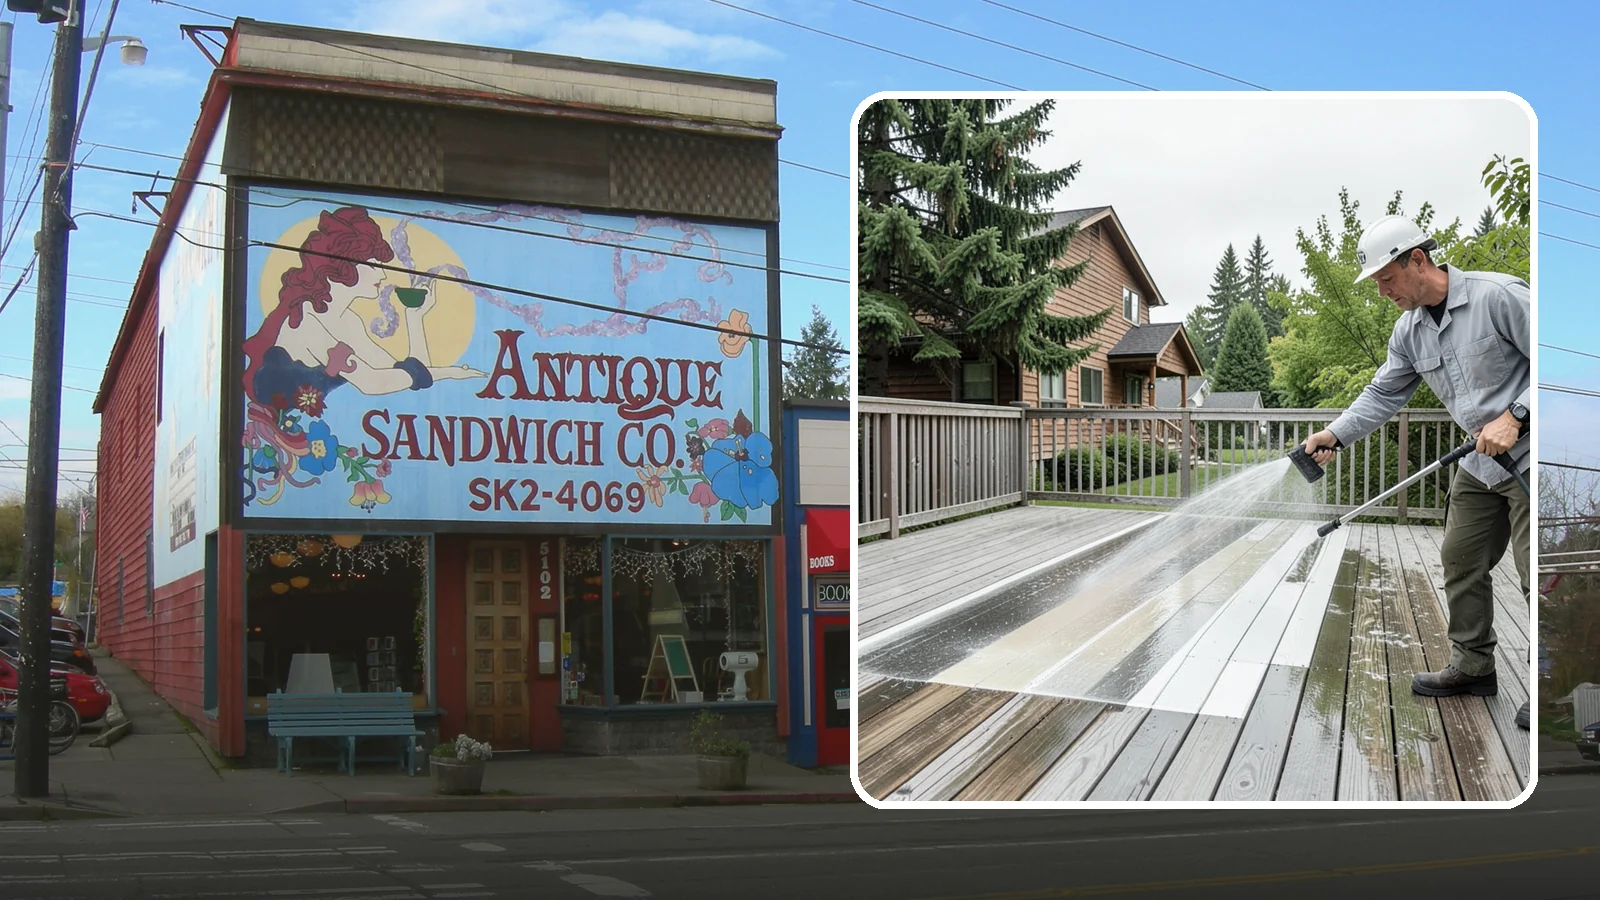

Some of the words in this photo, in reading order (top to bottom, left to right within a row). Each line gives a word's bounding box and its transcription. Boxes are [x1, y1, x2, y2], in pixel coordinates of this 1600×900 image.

[476, 329, 723, 420] ANTIQUE
[361, 408, 604, 467] SANDWICH
[616, 421, 685, 468] CO.
[468, 477, 645, 512] SK2-4069
[540, 541, 552, 599] 5102
[809, 555, 835, 569] BOOKS
